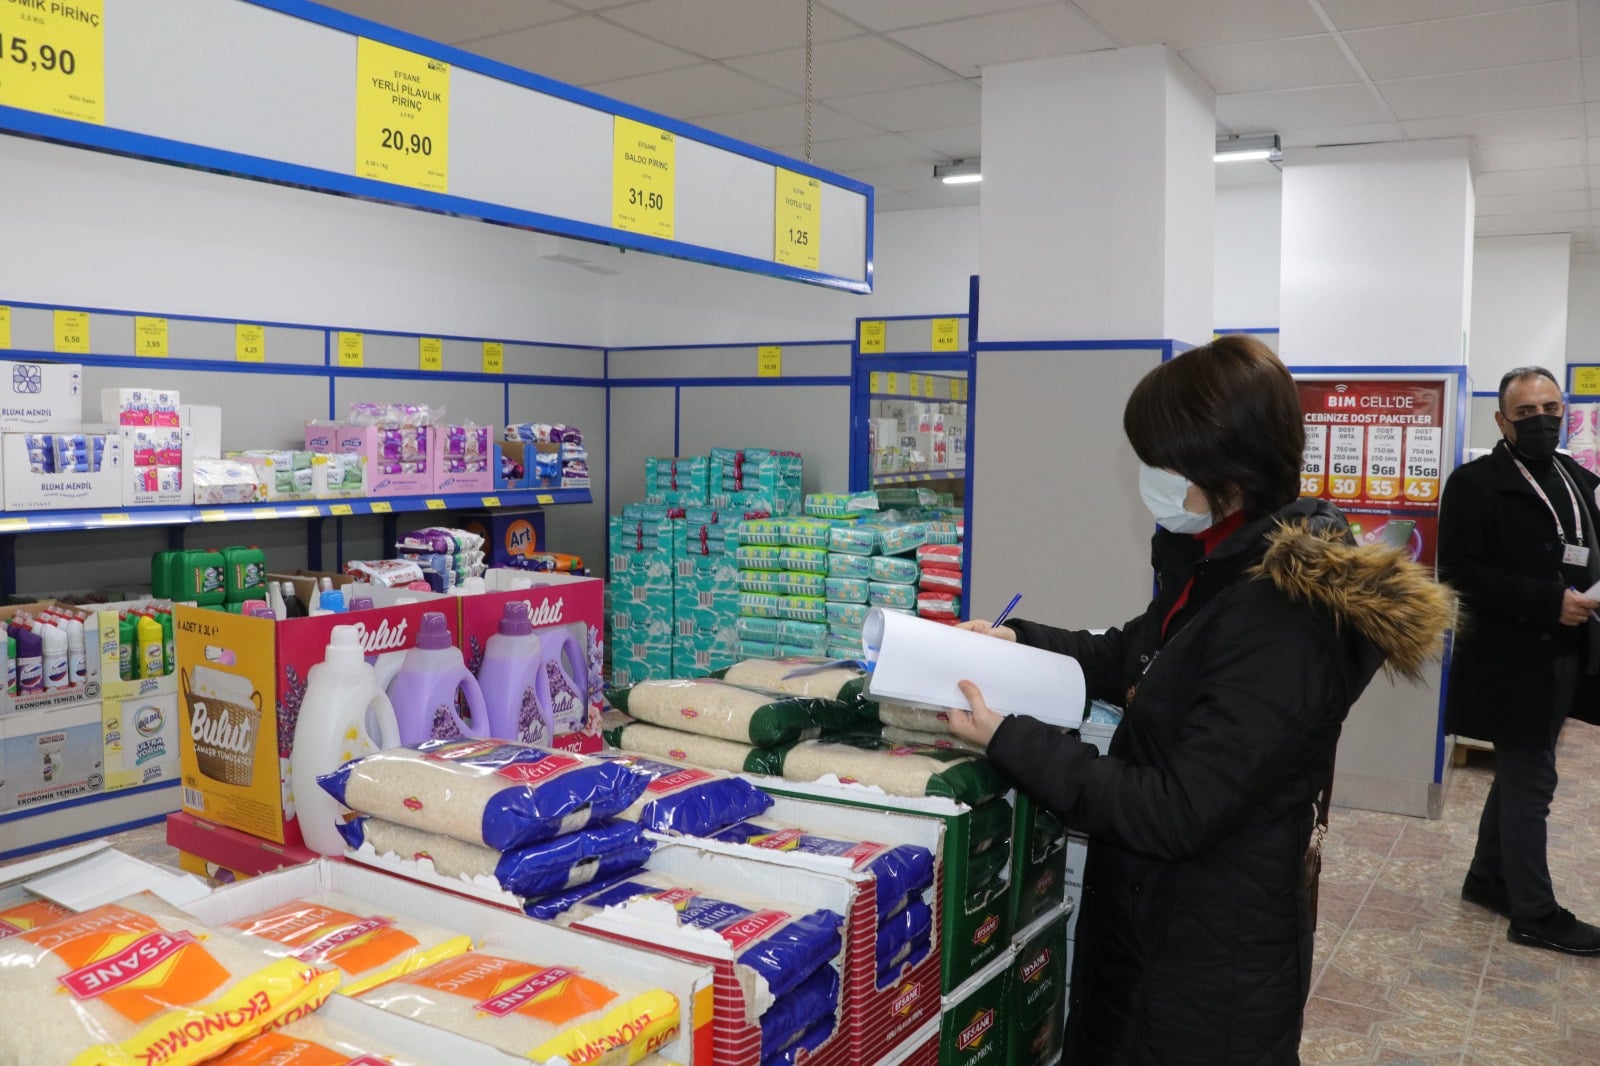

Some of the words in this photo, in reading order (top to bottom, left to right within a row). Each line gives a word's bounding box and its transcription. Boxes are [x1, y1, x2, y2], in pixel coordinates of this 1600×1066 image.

[51, 0, 100, 28] PİRİNÇ
[394, 71, 421, 83] EFSANE
[372, 77, 399, 93] YERLİ
[402, 84, 441, 103] PİLAVLIK
[392, 95, 422, 112] PİRİNÇ
[381, 127, 433, 156] 20,90
[625, 152, 647, 165] BALDO
[629, 188, 663, 210] 31,50
[789, 228, 808, 246] 1,25
[1360, 396, 1413, 408] CELL'DE
[1, 408, 25, 417] BLUME
[26, 408, 52, 417] MENDİL
[1351, 414, 1378, 424] DOST
[1379, 414, 1432, 424] PAKETLER
[41, 482, 65, 491] BLUME
[66, 480, 92, 490] MENDİL
[1333, 479, 1356, 495] 30
[1369, 480, 1392, 496] 35
[1407, 481, 1432, 497] 43
[510, 527, 531, 548] Art
[182, 621, 196, 632] ADET
[15, 699, 52, 711] EKONOMİK
[53, 693, 84, 705] TEMİZLİK
[190, 701, 251, 754] Bulut
[518, 761, 557, 779] Yerli
[660, 773, 693, 784] Yerli
[17, 793, 54, 806] EKONOMİK
[56, 786, 86, 798] TEMİZLİK
[730, 916, 768, 937] Yerli
[977, 920, 996, 938] EFSANE
[1023, 953, 1046, 976] EFSANE
[436, 959, 508, 991] PİRİNÇ
[491, 969, 567, 1009] EFSANE
[895, 987, 918, 1011] EFSANE
[134, 991, 271, 1066] EKONOMİK
[962, 1014, 990, 1043] EFSANE
